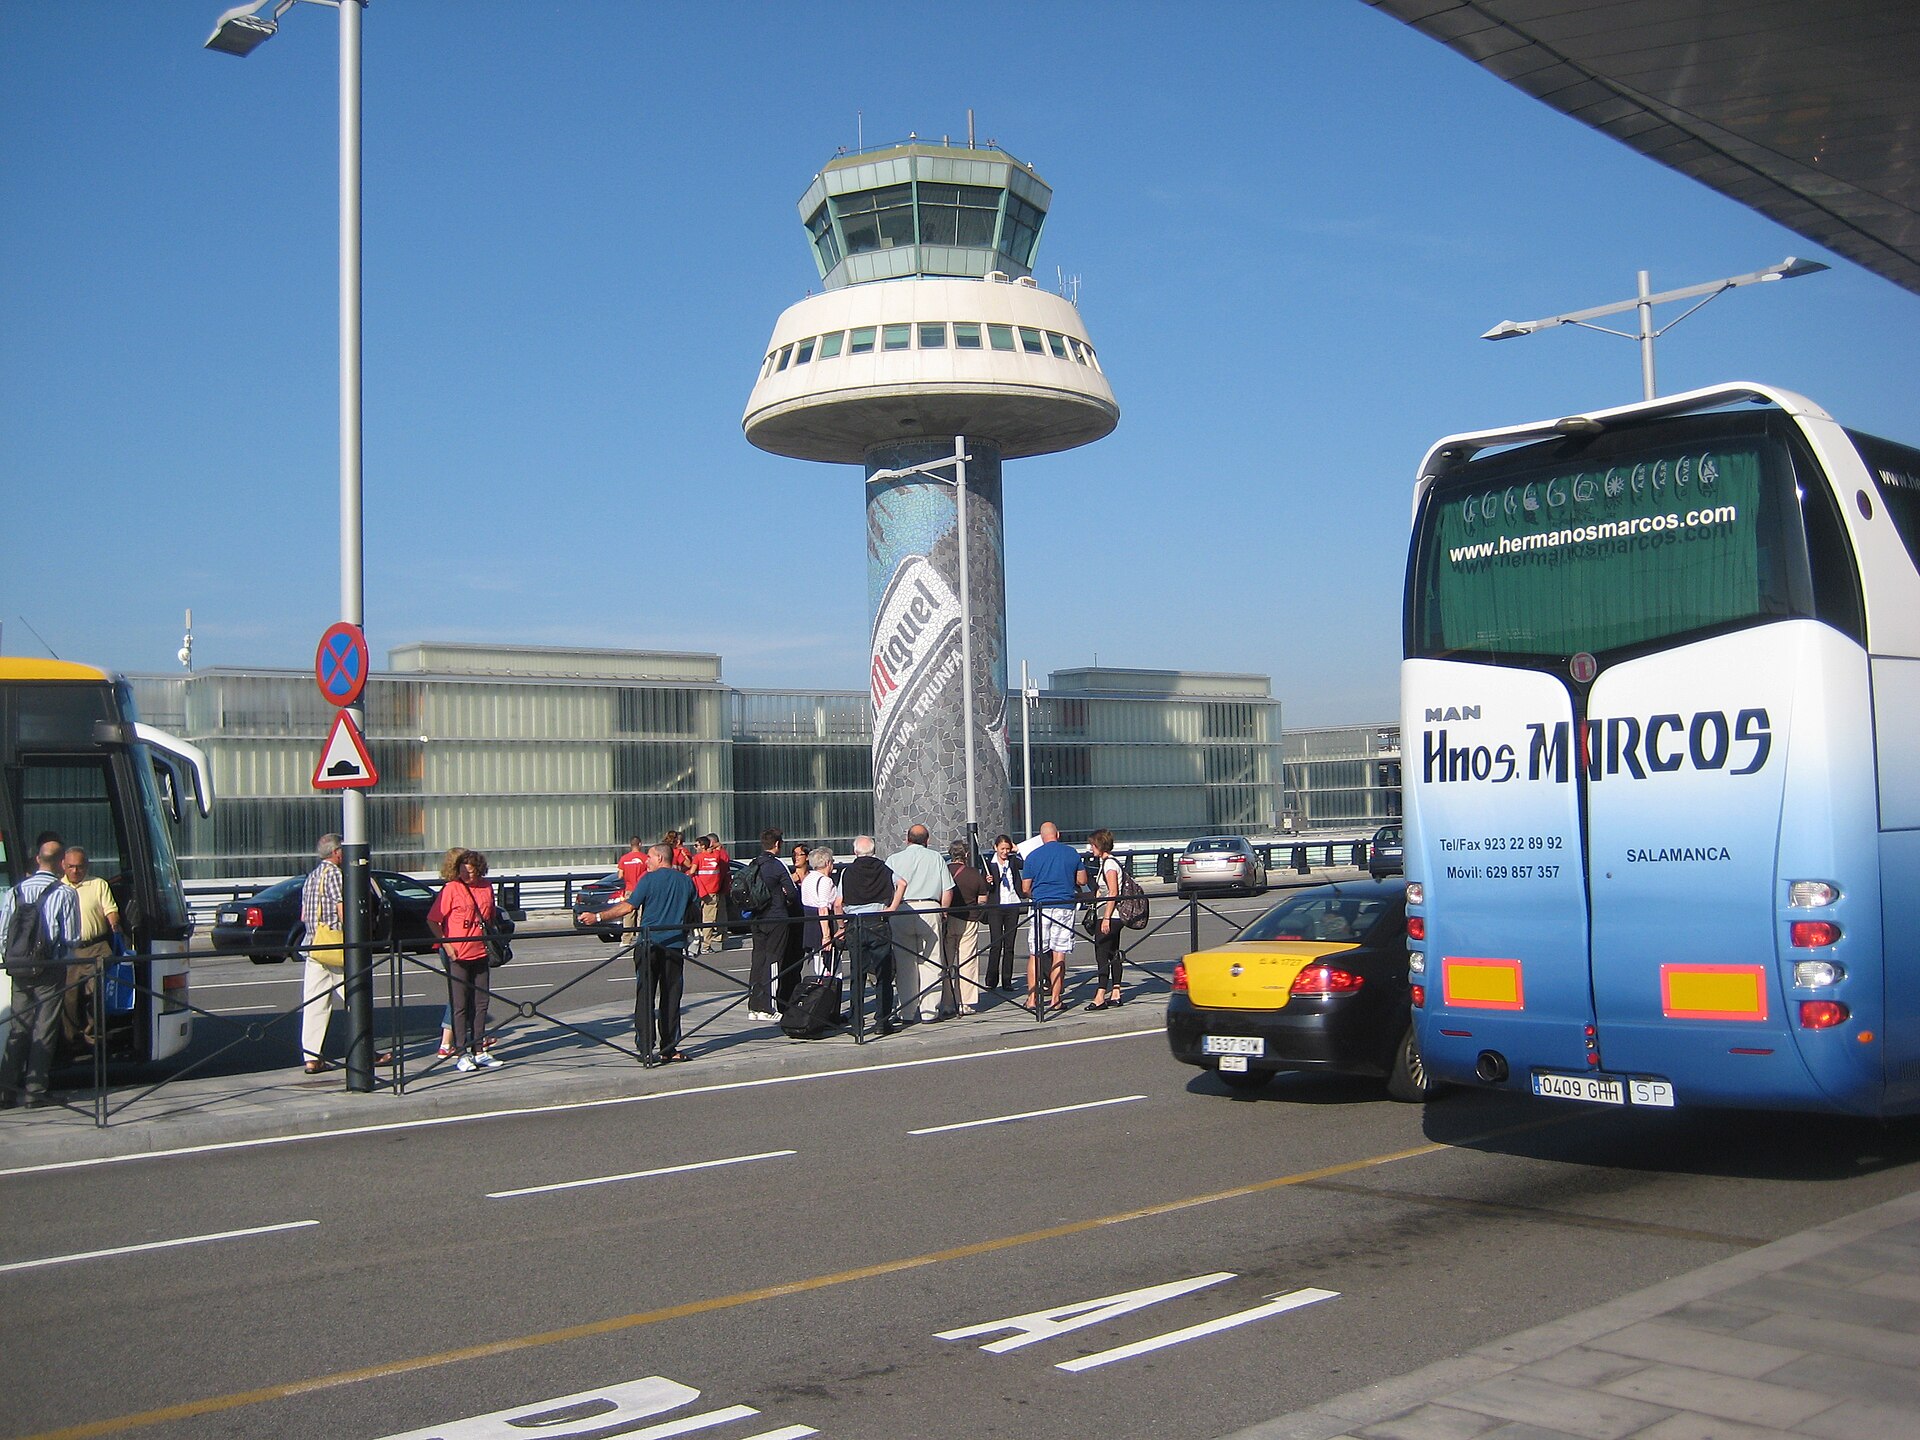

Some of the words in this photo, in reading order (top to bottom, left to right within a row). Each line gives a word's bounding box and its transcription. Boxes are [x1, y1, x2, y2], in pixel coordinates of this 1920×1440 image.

[1637, 465, 1646, 489] A.B.S.
[1681, 459, 1690, 482] D.V.D.
[1450, 505, 1736, 562] www.hermanosmarcos.com
[875, 741, 902, 801] DONDE
[911, 648, 964, 718] TRIUNFA
[1425, 705, 1481, 722] MAN
[1423, 729, 1520, 783] Hnos.
[1440, 838, 1481, 851] Tel/Fax
[1484, 837, 1506, 850] 923
[1510, 837, 1525, 850] 22
[1528, 836, 1543, 849] 89
[1547, 836, 1562, 849] 92
[1626, 847, 1731, 862] SALAMANCA
[1447, 866, 1482, 879] Móvil:
[1486, 866, 1507, 879] 629
[1511, 866, 1533, 878] 857
[1537, 865, 1560, 878] 357
[1542, 1077, 1582, 1097] 0409
[1588, 1082, 1619, 1101] GHH
[1636, 1084, 1666, 1102] SP
